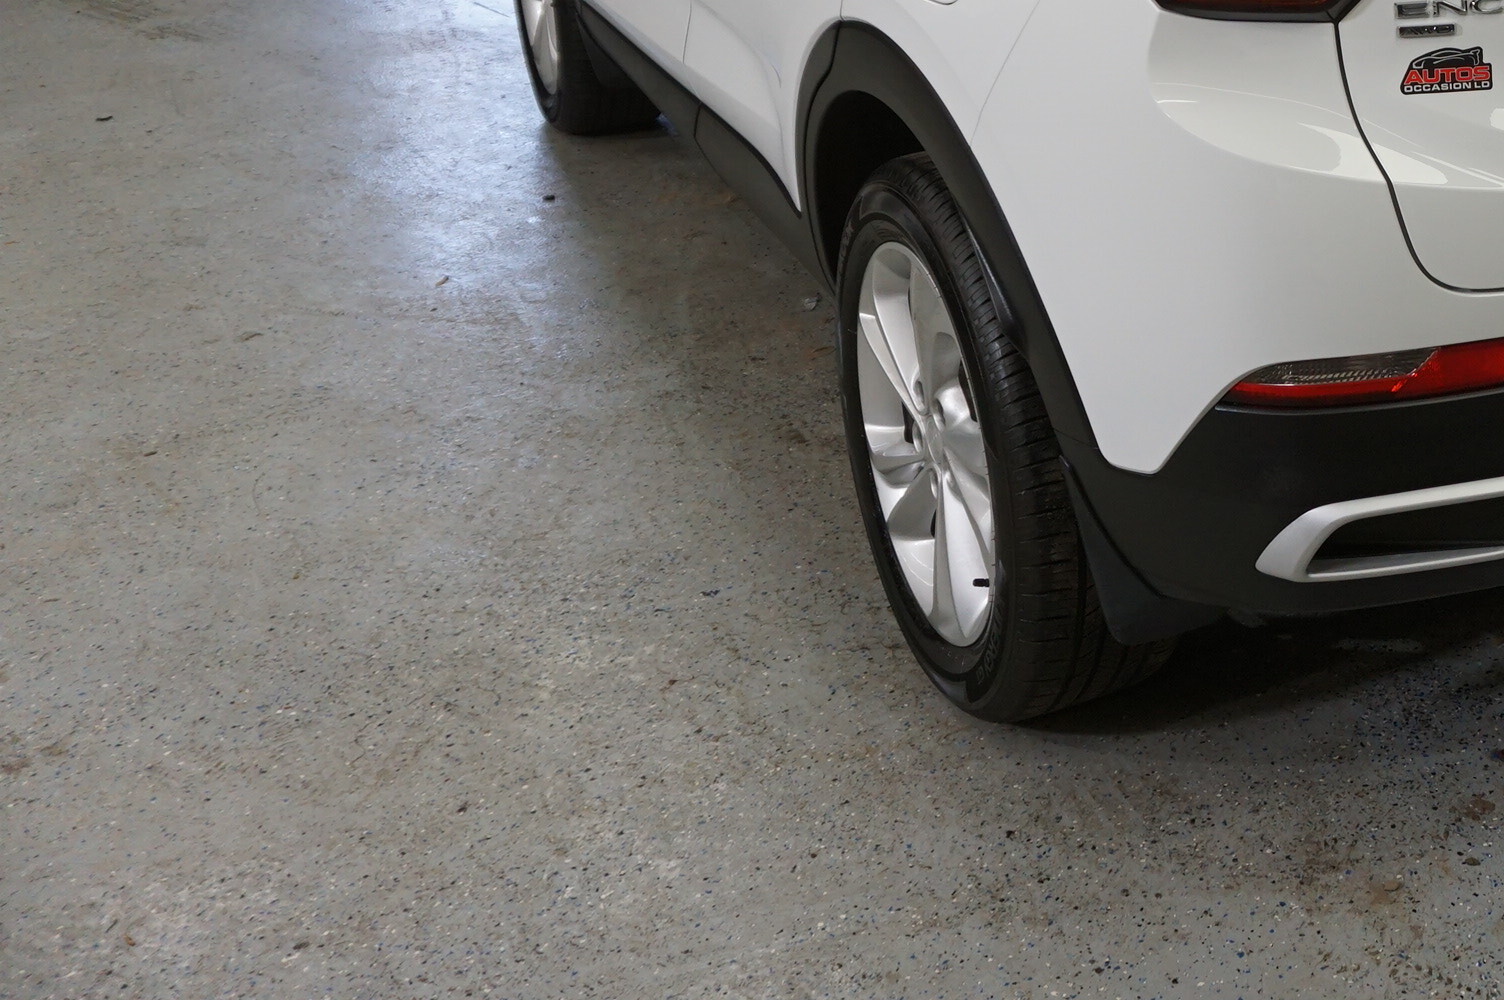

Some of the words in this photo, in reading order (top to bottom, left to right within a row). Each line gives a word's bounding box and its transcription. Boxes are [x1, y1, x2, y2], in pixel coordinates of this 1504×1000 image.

[1403, 65, 1491, 85] AUTOS
[1403, 82, 1472, 93] OCCASION
[1474, 81, 1490, 89] LD
